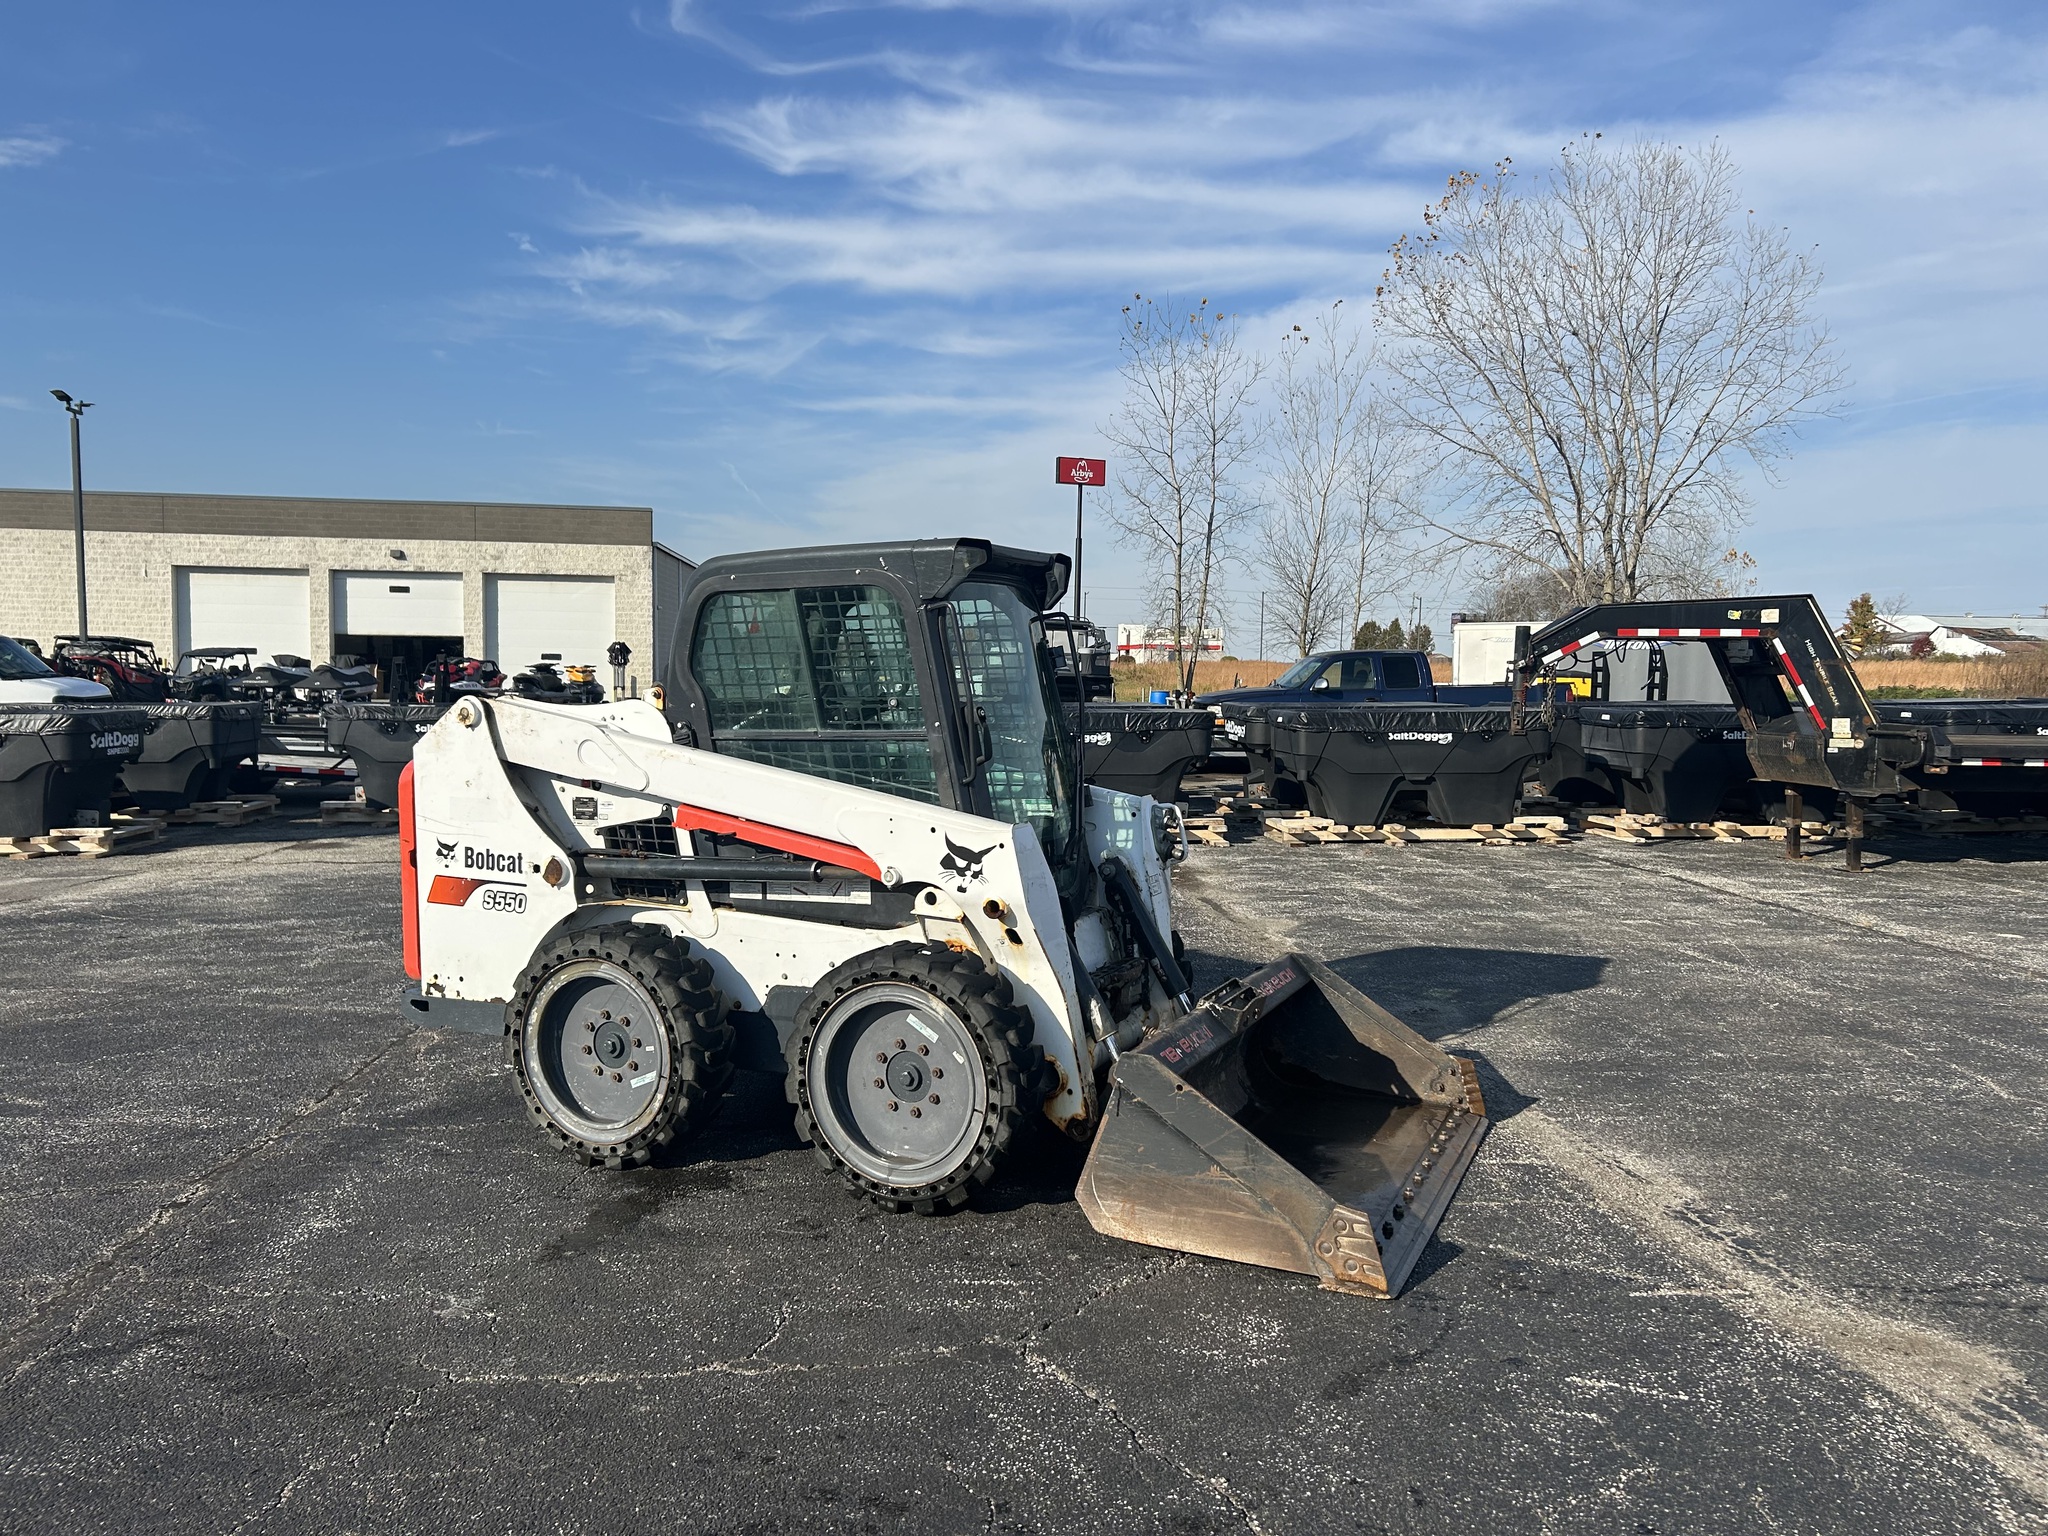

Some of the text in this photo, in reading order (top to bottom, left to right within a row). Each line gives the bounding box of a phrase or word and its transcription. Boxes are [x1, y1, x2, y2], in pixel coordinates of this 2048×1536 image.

[1071, 469, 1093, 479] Arby's
[90, 731, 139, 749] SaltDogg
[1388, 732, 1440, 742] SaltDogg
[464, 846, 523, 874] Bobcat
[482, 889, 528, 914] S550
